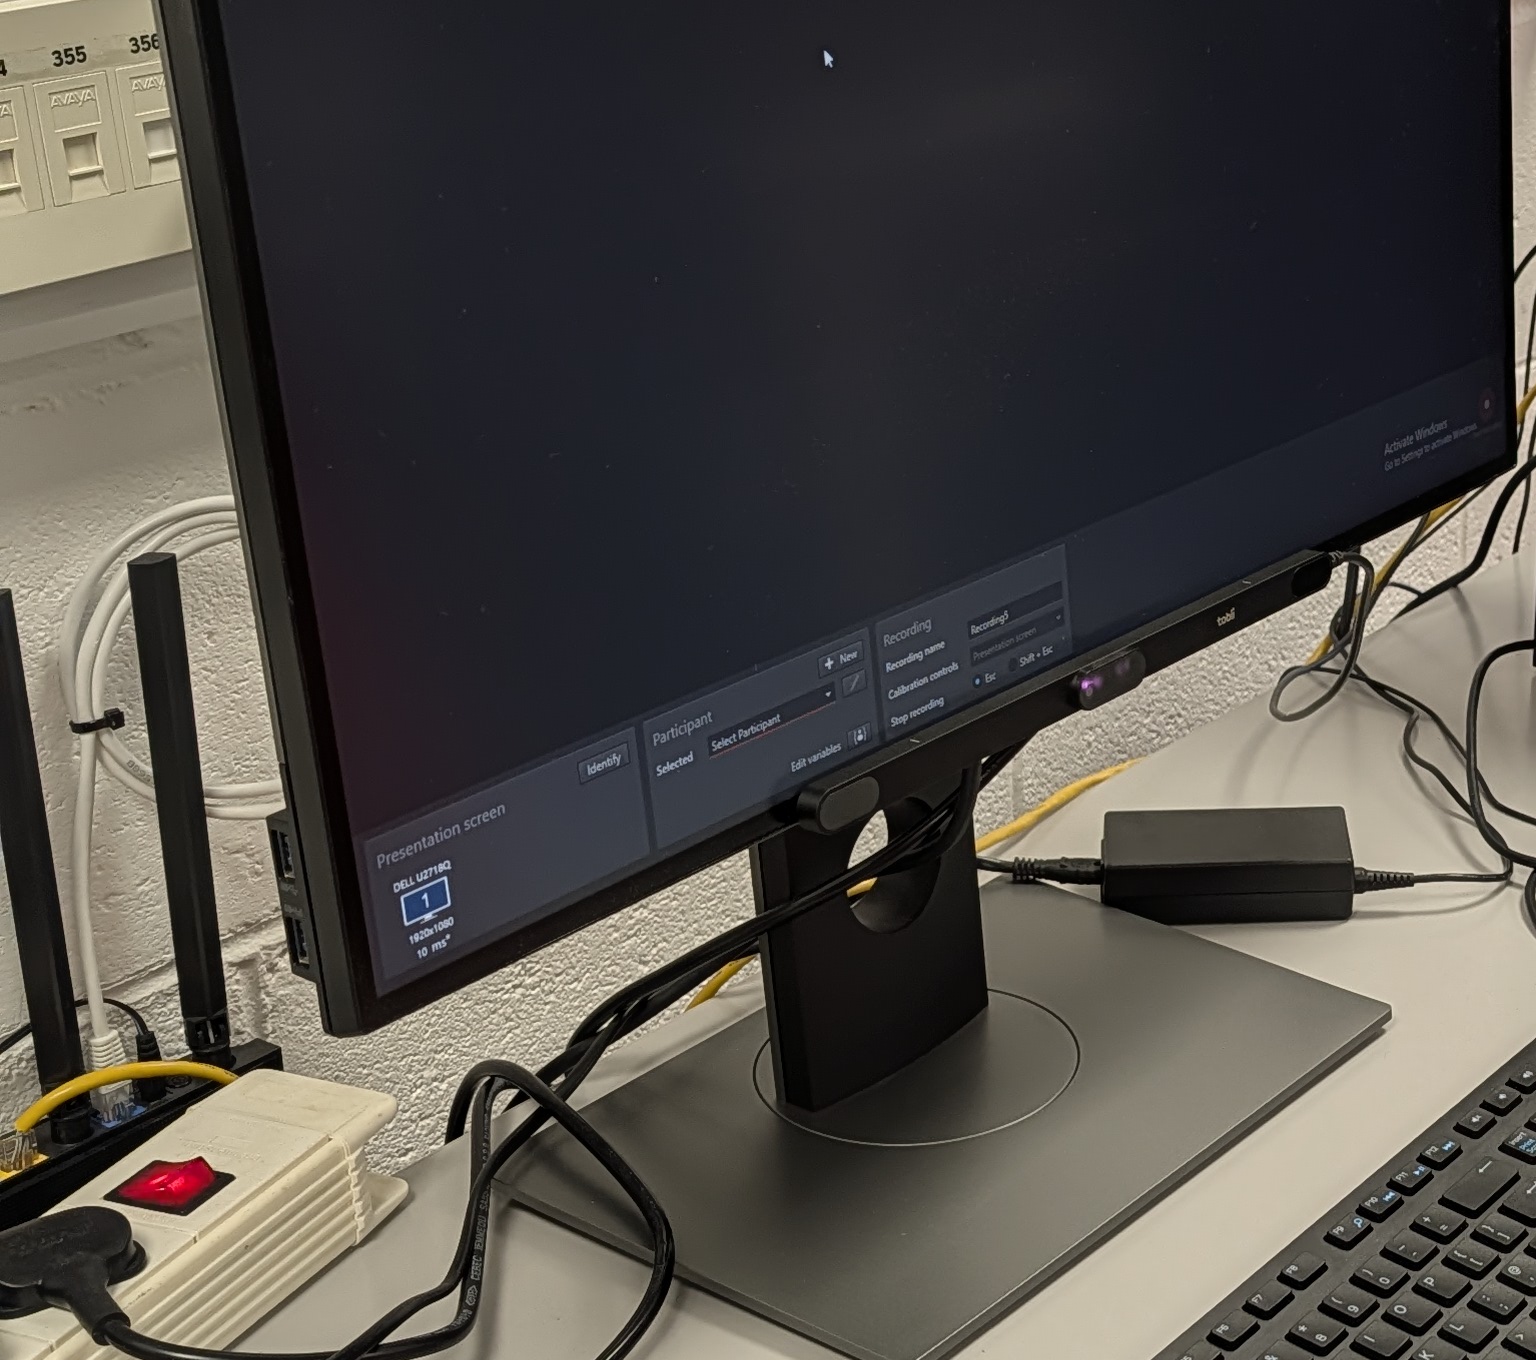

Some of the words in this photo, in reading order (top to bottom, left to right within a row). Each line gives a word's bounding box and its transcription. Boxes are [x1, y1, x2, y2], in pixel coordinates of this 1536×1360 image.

[52, 46, 87, 67] 355
[131, 74, 165, 92] AVAY
[51, 89, 94, 109] AVAYA
[883, 618, 932, 647] Recording
[840, 650, 857, 664] New
[885, 650, 923, 672] Recording
[924, 641, 945, 656] name
[973, 638, 1014, 661] Presentation
[1020, 653, 1034, 667] Shift
[1042, 646, 1053, 656] Esc
[888, 675, 928, 700] Calibration
[930, 662, 958, 681] controls
[985, 671, 996, 683] Esc
[891, 713, 908, 727] Stop
[910, 697, 944, 718] recording
[653, 711, 713, 746] Participant
[712, 734, 736, 752] Select
[738, 714, 781, 740] Participant
[587, 754, 621, 776] Identify
[656, 751, 693, 777] Selected
[791, 758, 806, 772] Edit
[808, 742, 841, 765] variables
[376, 822, 460, 869] Presentation
[464, 803, 506, 831] screen
[393, 875, 414, 893] DELL
[421, 893, 429, 908] 1
[409, 917, 454, 944] 1920x1080
[417, 947, 427, 959] 10
[1364, 1196, 1378, 1206] F10
[1333, 1226, 1344, 1235] F9
[1286, 1265, 1298, 1274] F8
[1423, 1277, 1435, 1287] P
[1251, 1294, 1263, 1304] F7
[1348, 1305, 1359, 1313] 9
[1394, 1305, 1407, 1314] O
[1217, 1324, 1229, 1334] F6
[1449, 1323, 1464, 1331] L
[1315, 1333, 1327, 1341] 8
[1418, 1350, 1435, 1360] K
